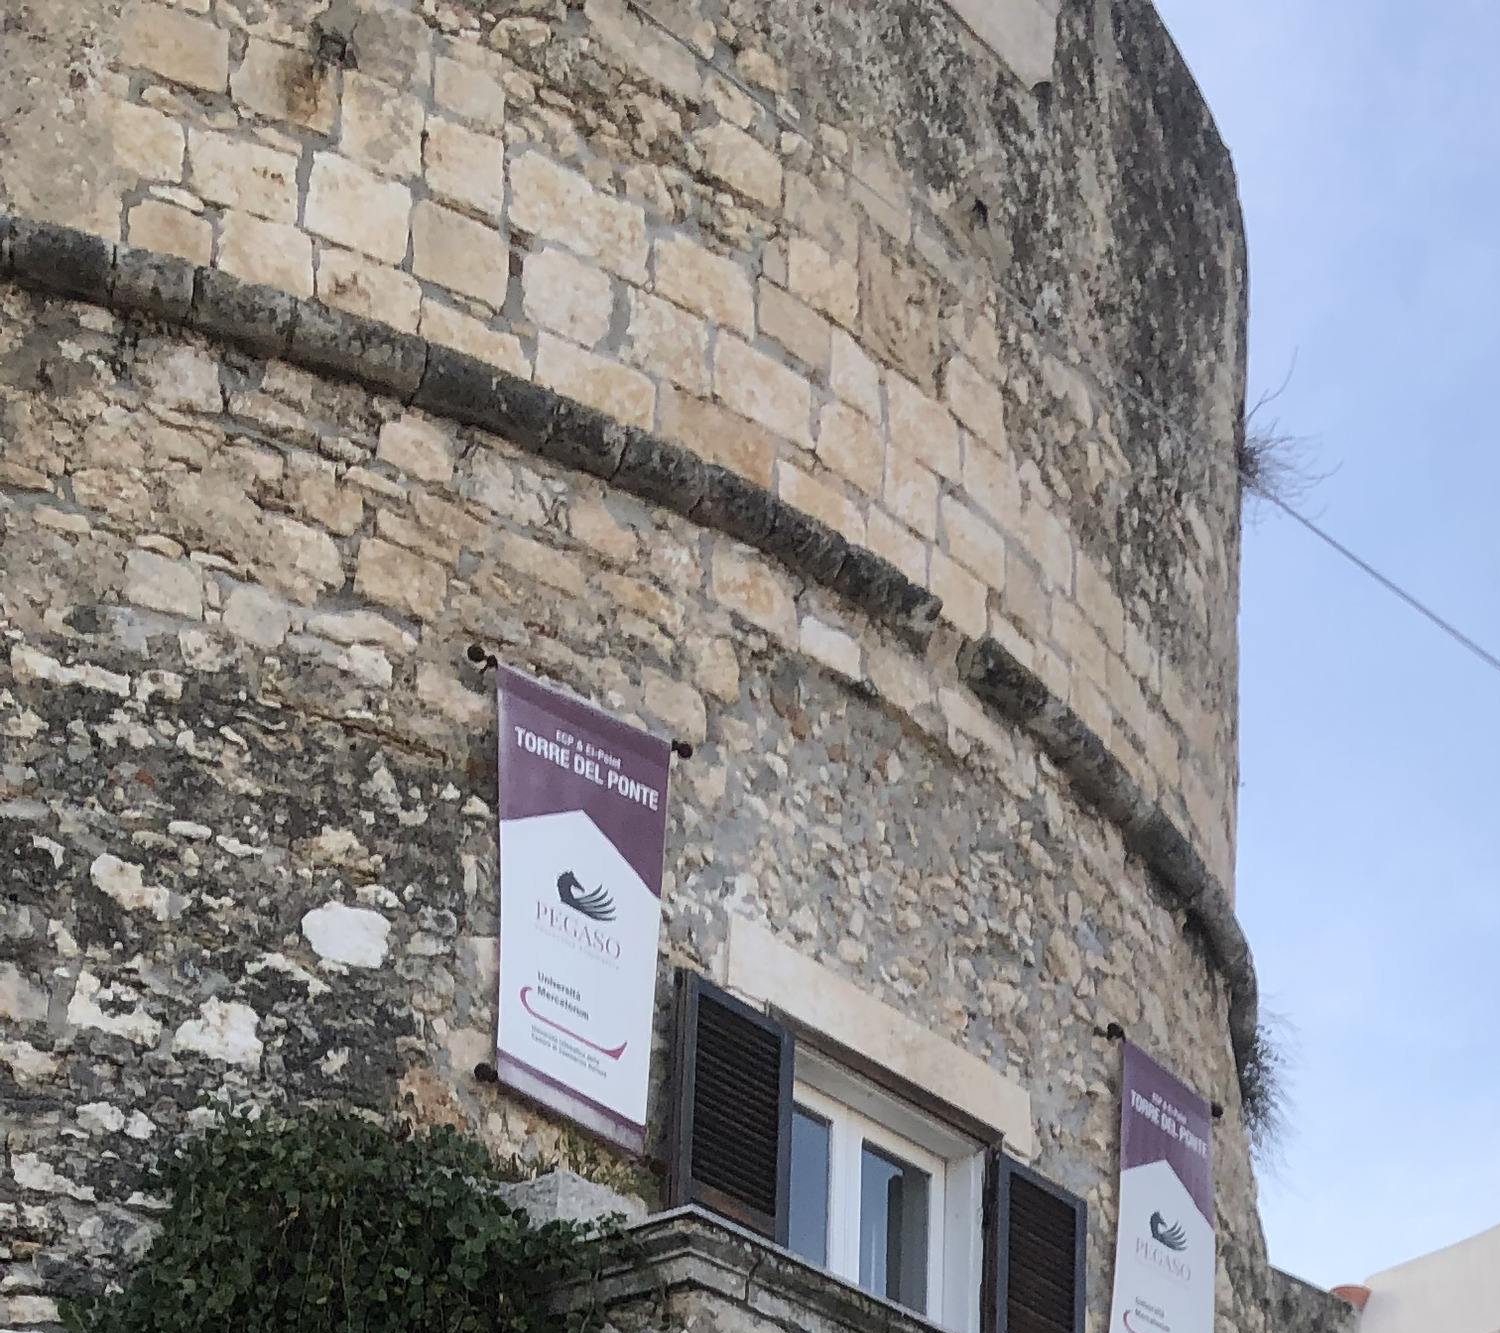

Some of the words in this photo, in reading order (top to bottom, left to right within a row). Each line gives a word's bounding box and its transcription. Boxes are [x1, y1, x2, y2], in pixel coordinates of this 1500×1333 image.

[514, 725, 570, 769] TORRE
[574, 752, 604, 785] DEL
[607, 769, 659, 812] PONTE
[535, 900, 621, 959] PEGASO
